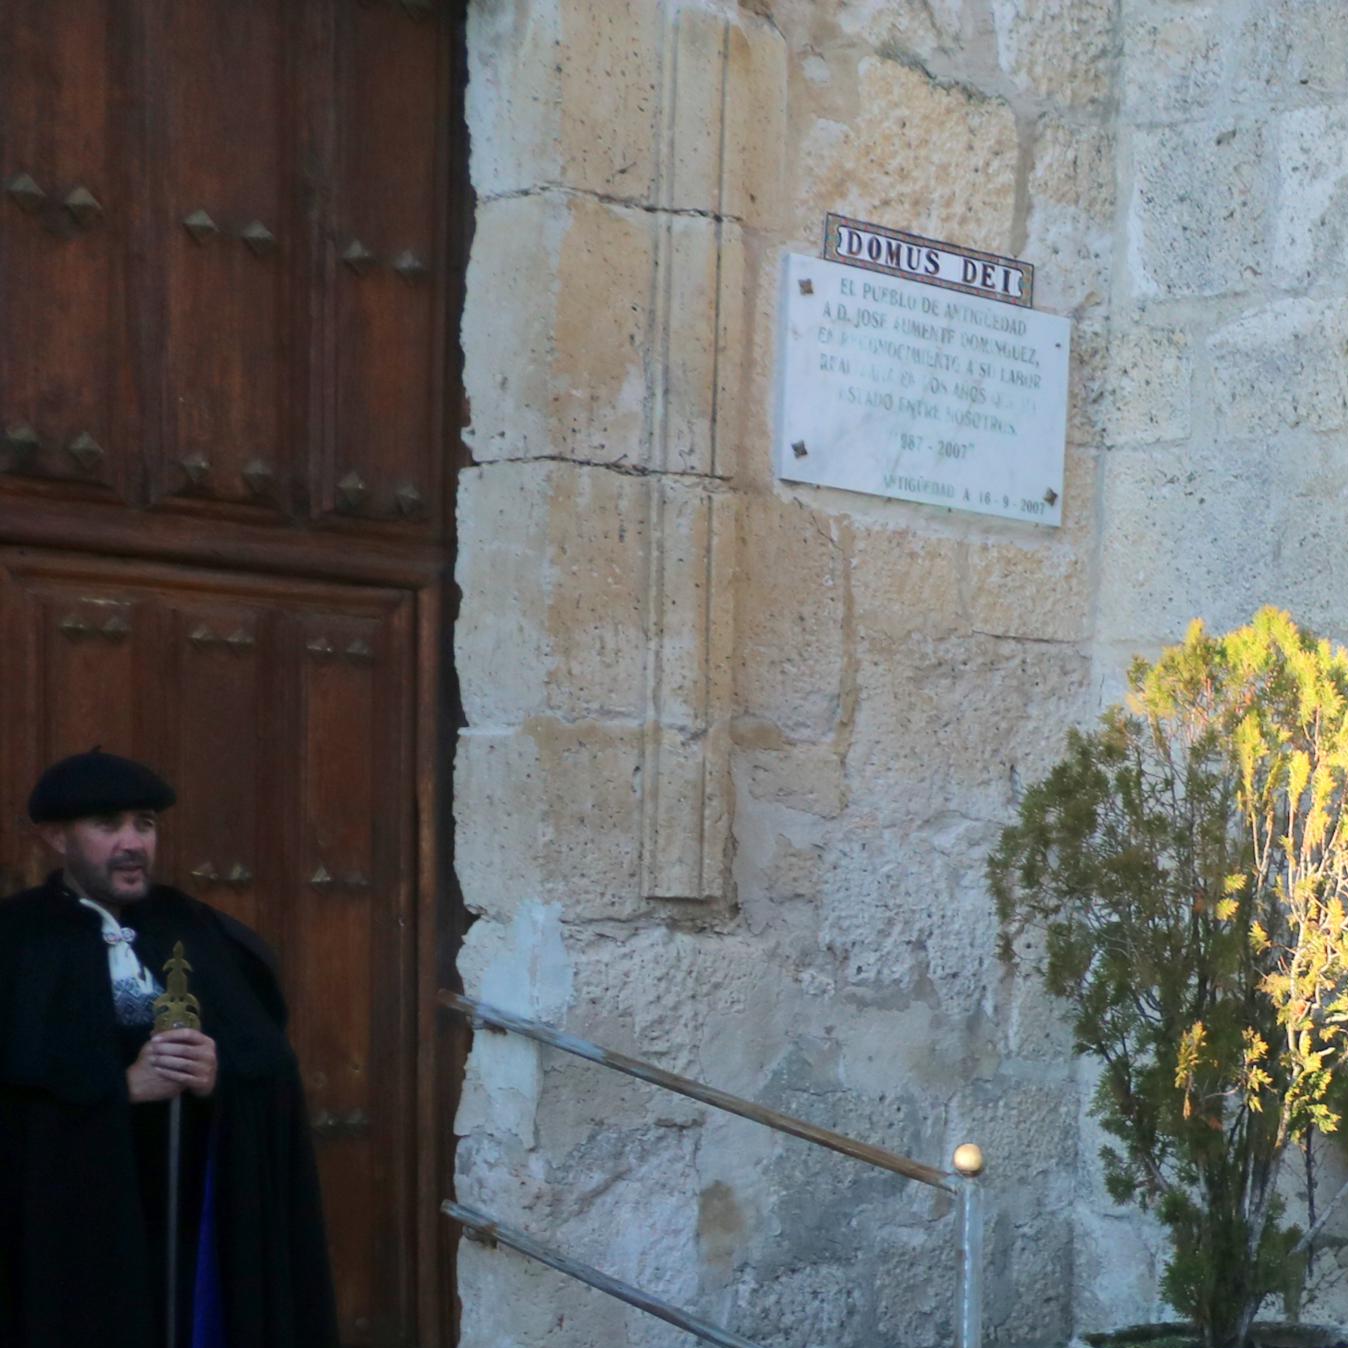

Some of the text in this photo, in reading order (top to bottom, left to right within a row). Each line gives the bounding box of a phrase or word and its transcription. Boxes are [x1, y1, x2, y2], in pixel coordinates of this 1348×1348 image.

[846, 229, 1012, 294] DOMUS DEI
[839, 276, 855, 296] EL
[862, 282, 917, 311] PUEBLO
[920, 295, 939, 316] DE
[821, 298, 832, 318] A
[836, 301, 851, 323] D.
[922, 373, 948, 397] OS
[999, 366, 1042, 390] LABOR
[961, 486, 970, 502] A
